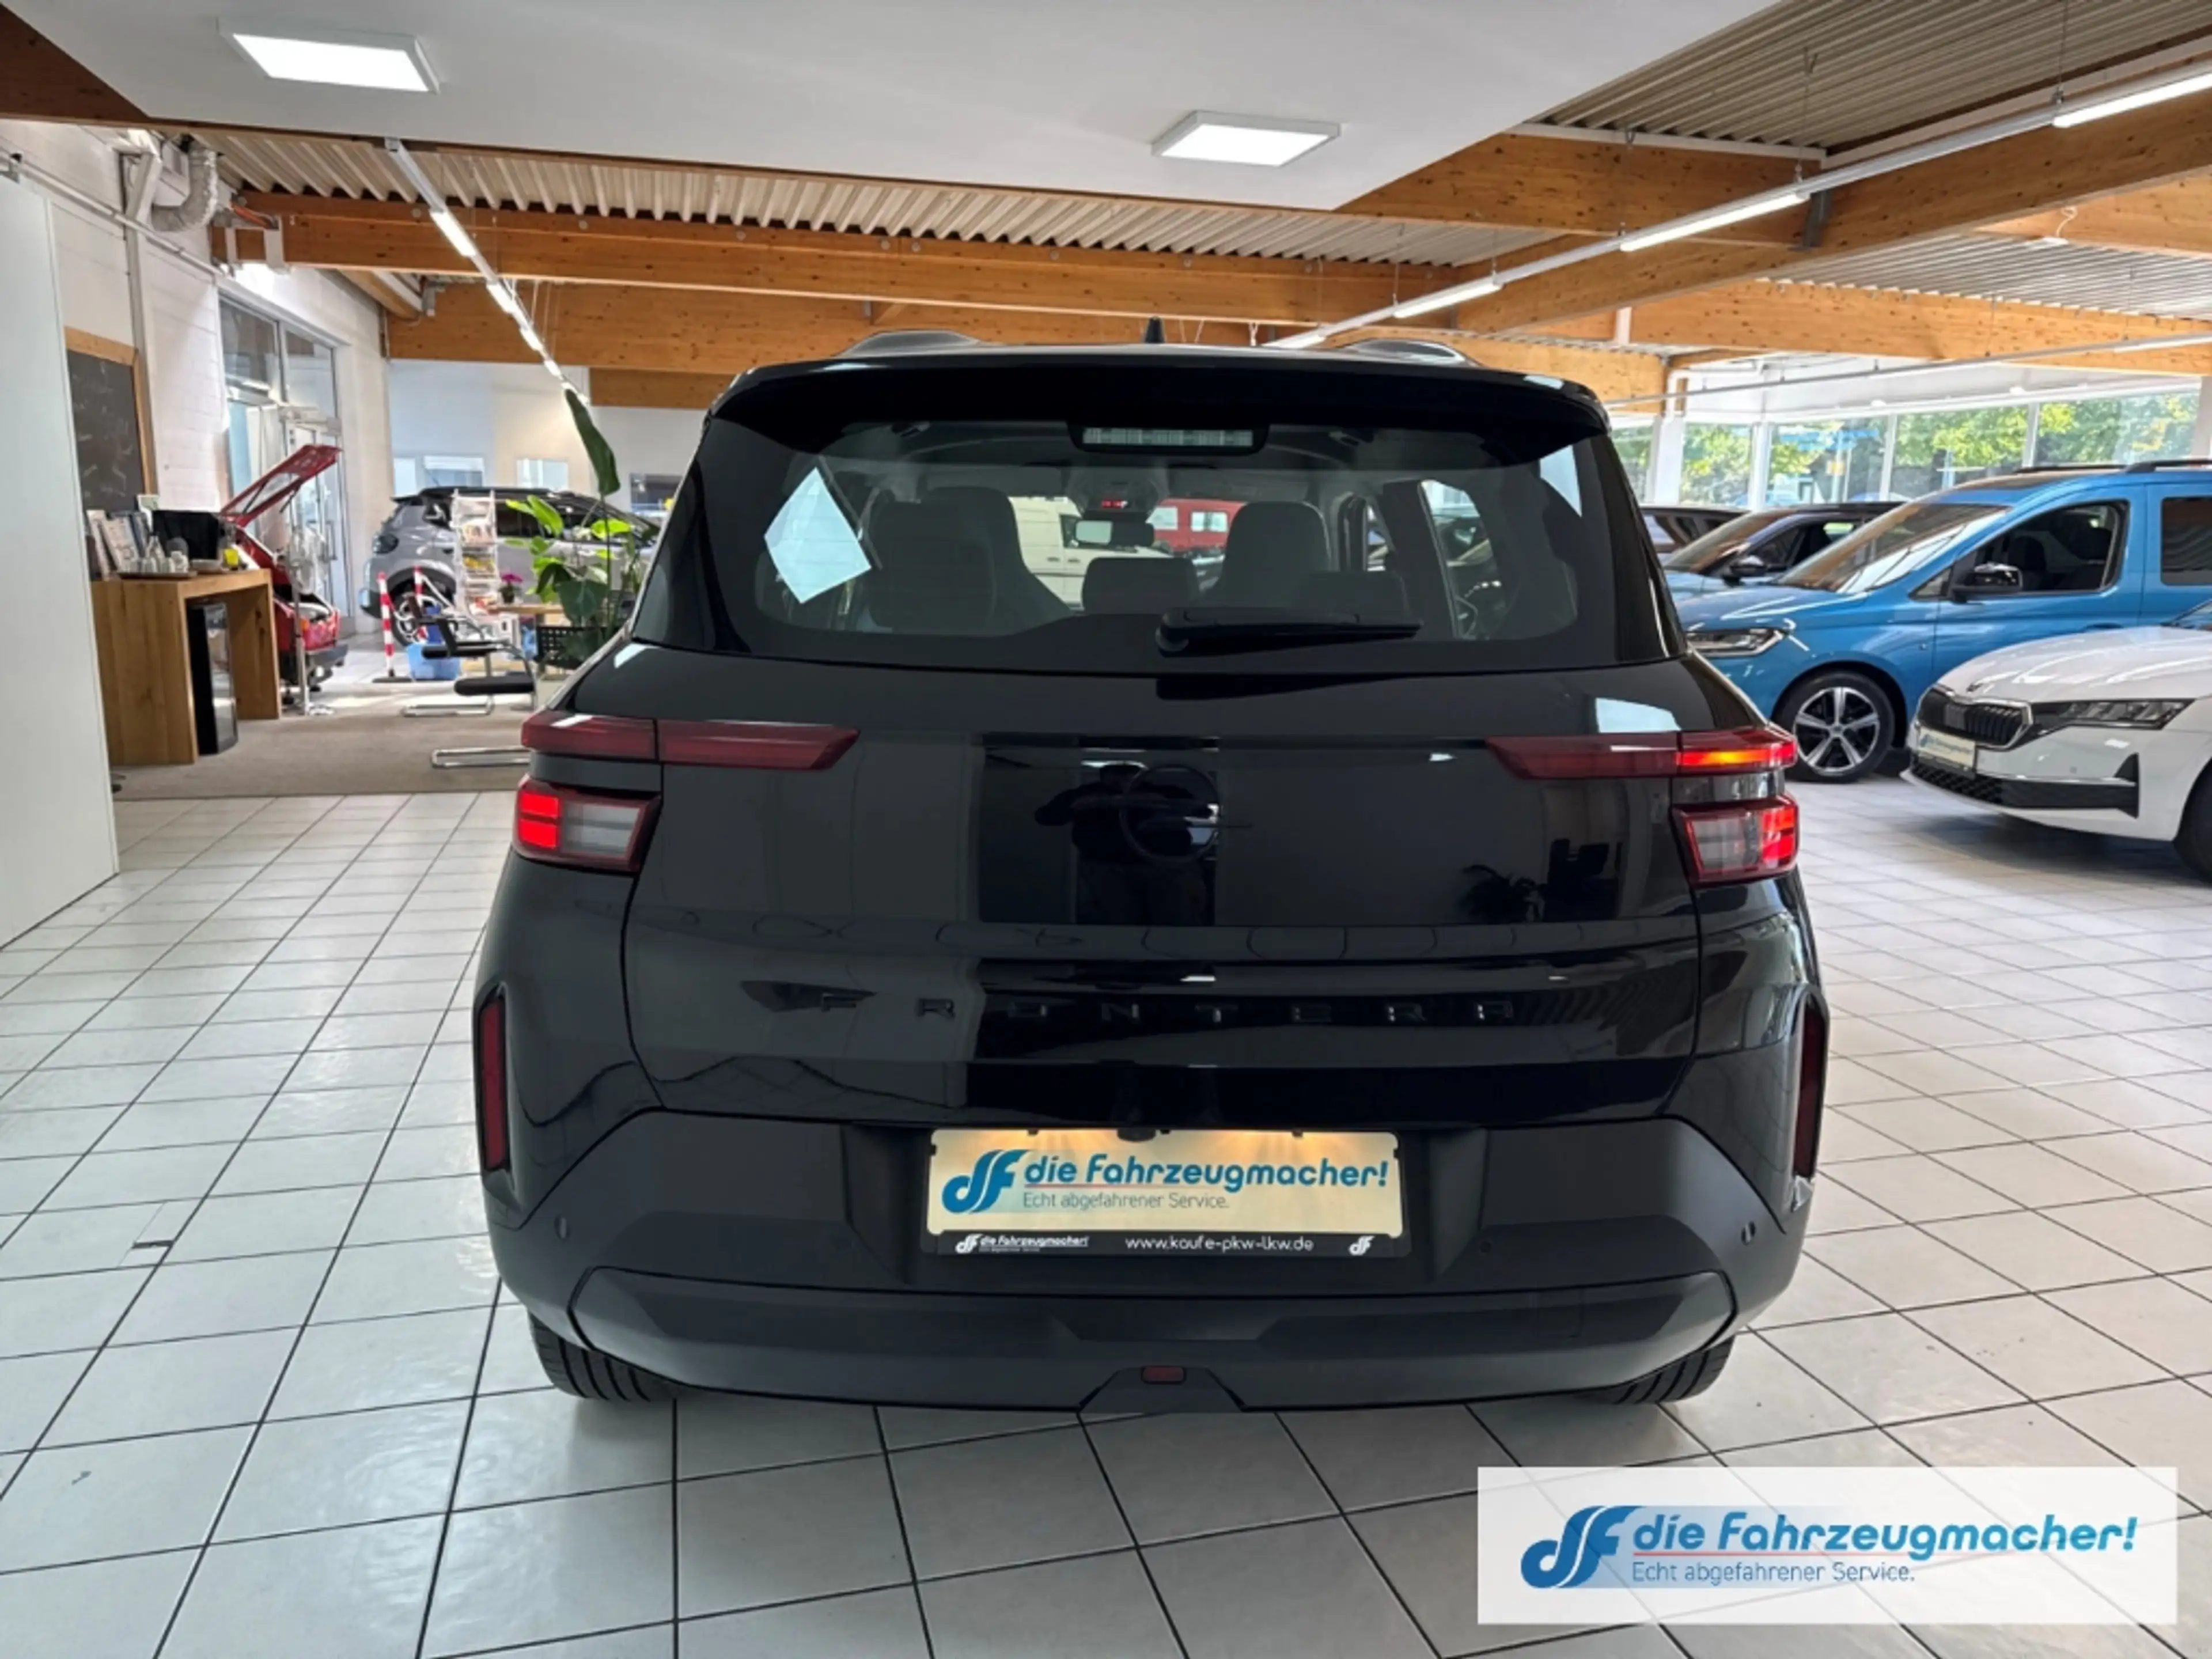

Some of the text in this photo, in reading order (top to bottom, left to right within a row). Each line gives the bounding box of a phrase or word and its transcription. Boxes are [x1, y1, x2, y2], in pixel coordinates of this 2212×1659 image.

[1024, 1154, 1388, 1193] die Fahrzeugmacher!
[1023, 1192, 1056, 1209] Echt
[1060, 1192, 1164, 1211] abgefahrener
